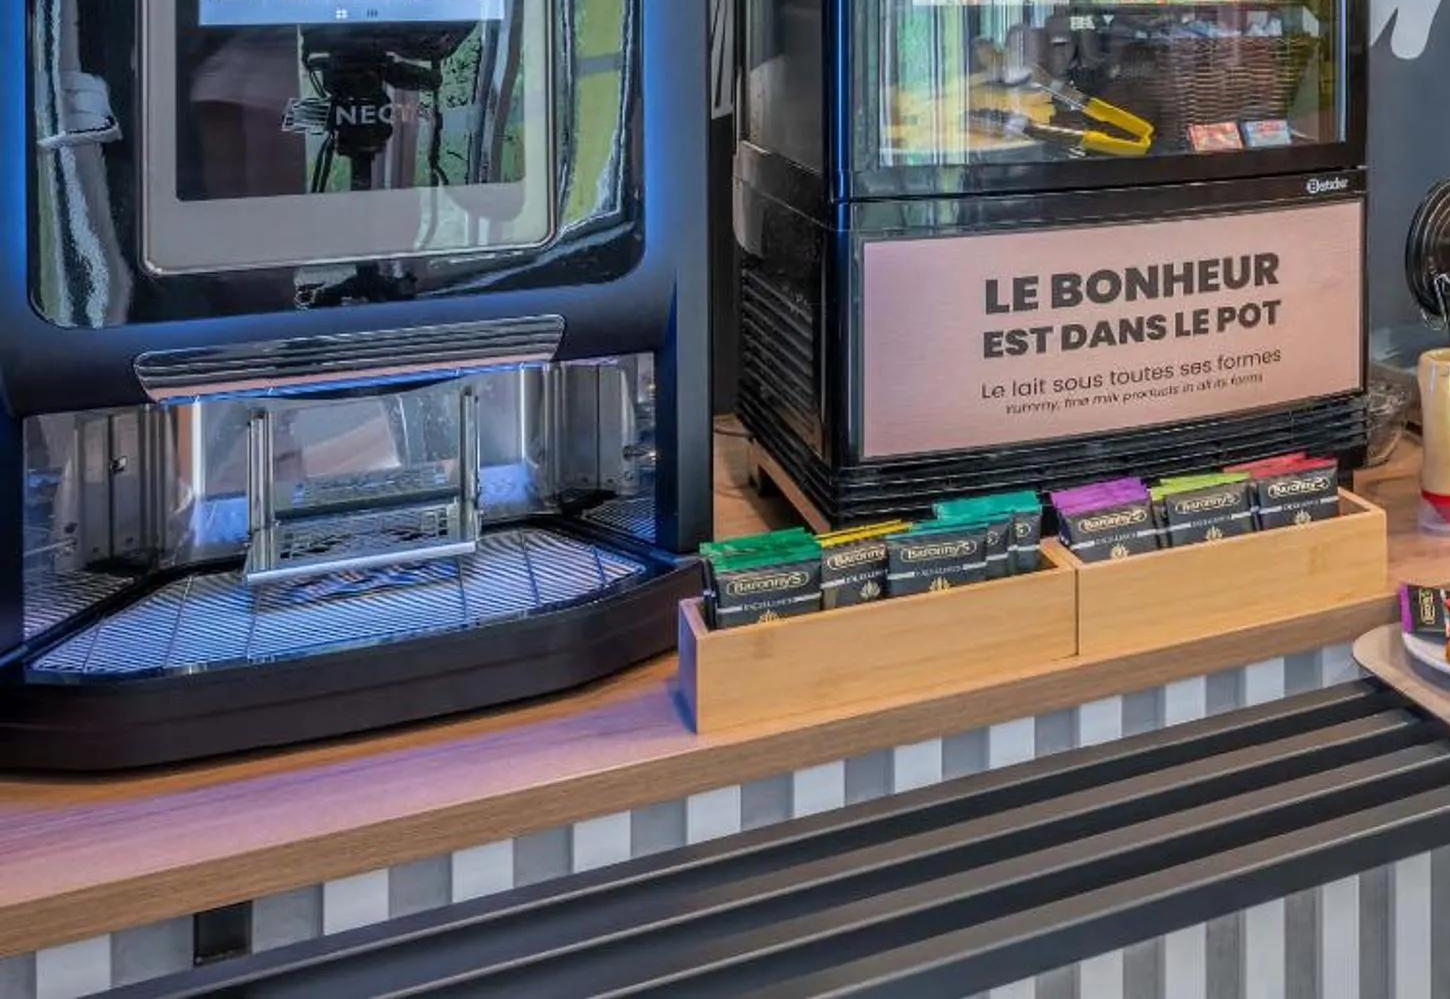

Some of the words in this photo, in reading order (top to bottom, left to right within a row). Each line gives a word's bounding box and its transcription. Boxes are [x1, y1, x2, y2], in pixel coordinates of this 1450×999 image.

[985, 275, 1039, 315] LE
[1051, 252, 1279, 309] BONHEUR
[983, 325, 1054, 359] EST
[1060, 314, 1167, 351] DANS
[1175, 308, 1209, 338] LE
[1217, 300, 1281, 333] POT
[981, 382, 1005, 400] Le
[1012, 378, 1045, 397] lait
[1053, 374, 1103, 394] sous
[1109, 364, 1174, 386] toutes
[1180, 360, 1212, 376] ses
[1217, 348, 1281, 370] formes
[1123, 384, 1179, 403] products
